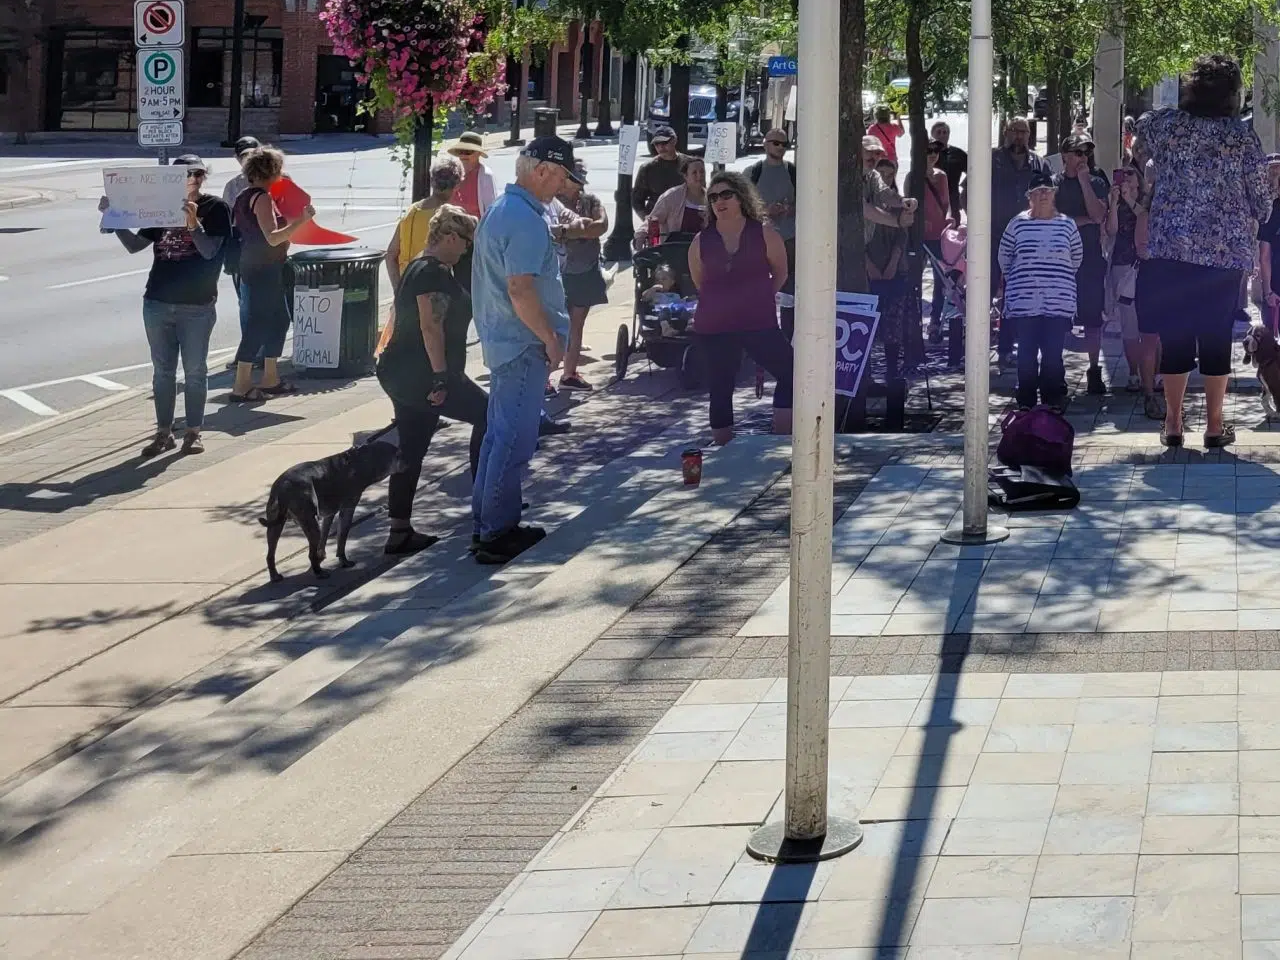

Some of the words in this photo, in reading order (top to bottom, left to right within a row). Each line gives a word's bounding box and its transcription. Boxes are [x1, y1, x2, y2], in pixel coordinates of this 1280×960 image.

[772, 61, 787, 70] Art
[144, 87, 149, 95] 2
[150, 86, 175, 95] HOUR
[309, 296, 331, 313] TO
[297, 315, 323, 334] MAL
[836, 361, 860, 373] PARTY
